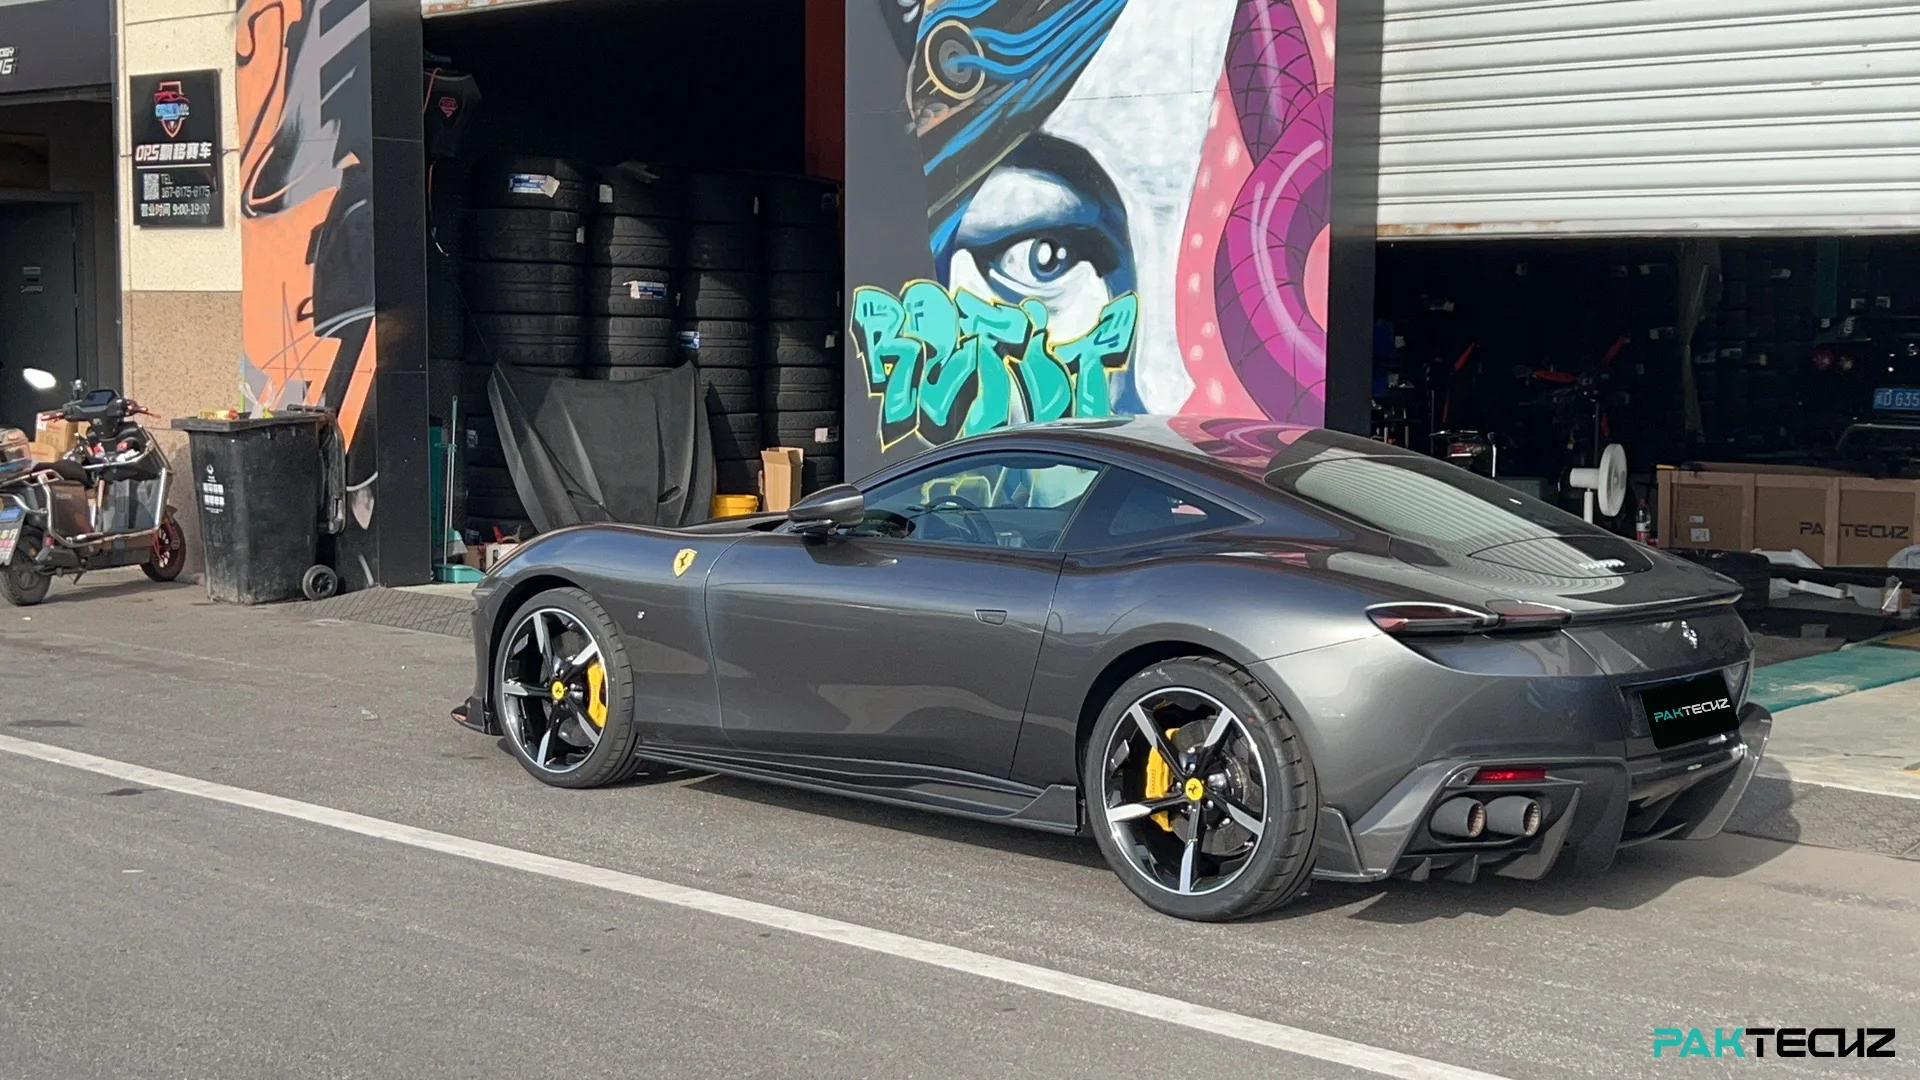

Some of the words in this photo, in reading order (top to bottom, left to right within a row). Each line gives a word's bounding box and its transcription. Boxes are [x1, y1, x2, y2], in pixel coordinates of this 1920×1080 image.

[141, 203, 171, 216] 营业时间
[1799, 521, 1909, 540] PATECHZ
